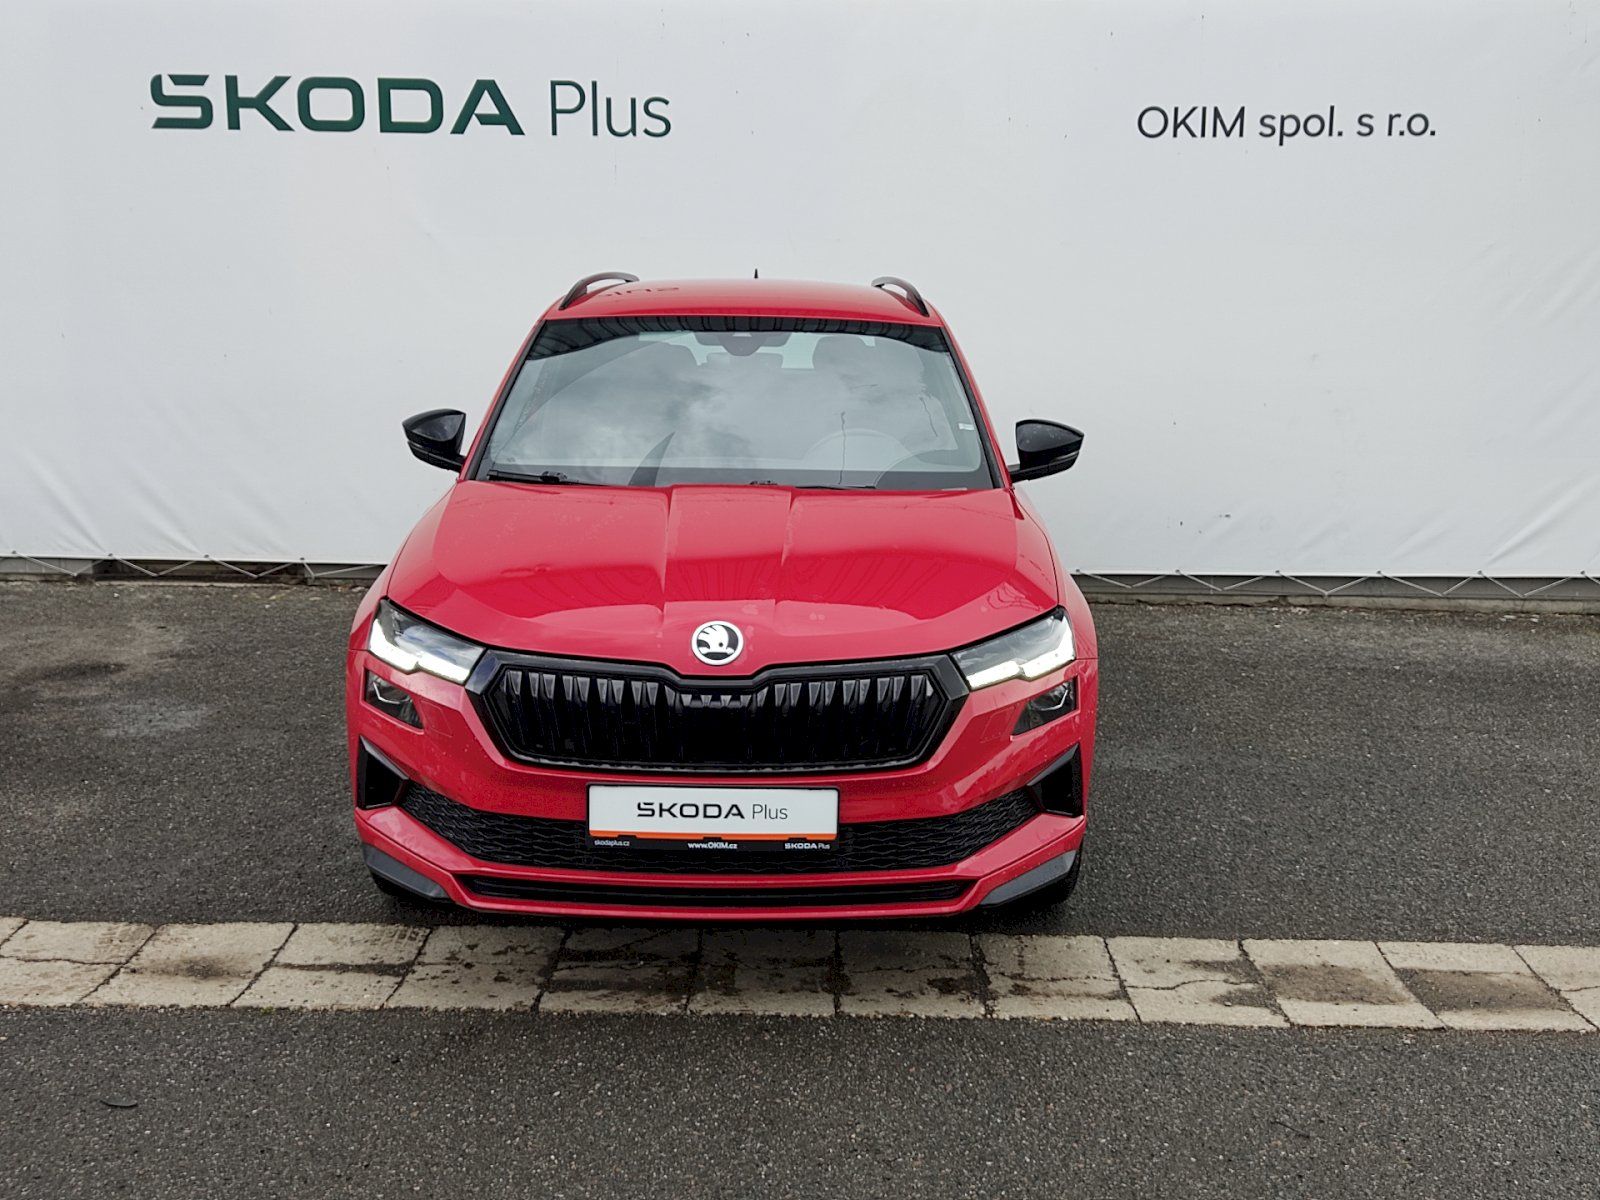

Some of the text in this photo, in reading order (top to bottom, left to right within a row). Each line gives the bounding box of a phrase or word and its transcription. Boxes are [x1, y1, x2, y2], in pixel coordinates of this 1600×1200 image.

[549, 80, 672, 138] Plus
[1136, 104, 1436, 147] OKIM spol. s r.o.
[751, 803, 789, 820] Plus
[687, 842, 738, 850] www.OKIM.cz
